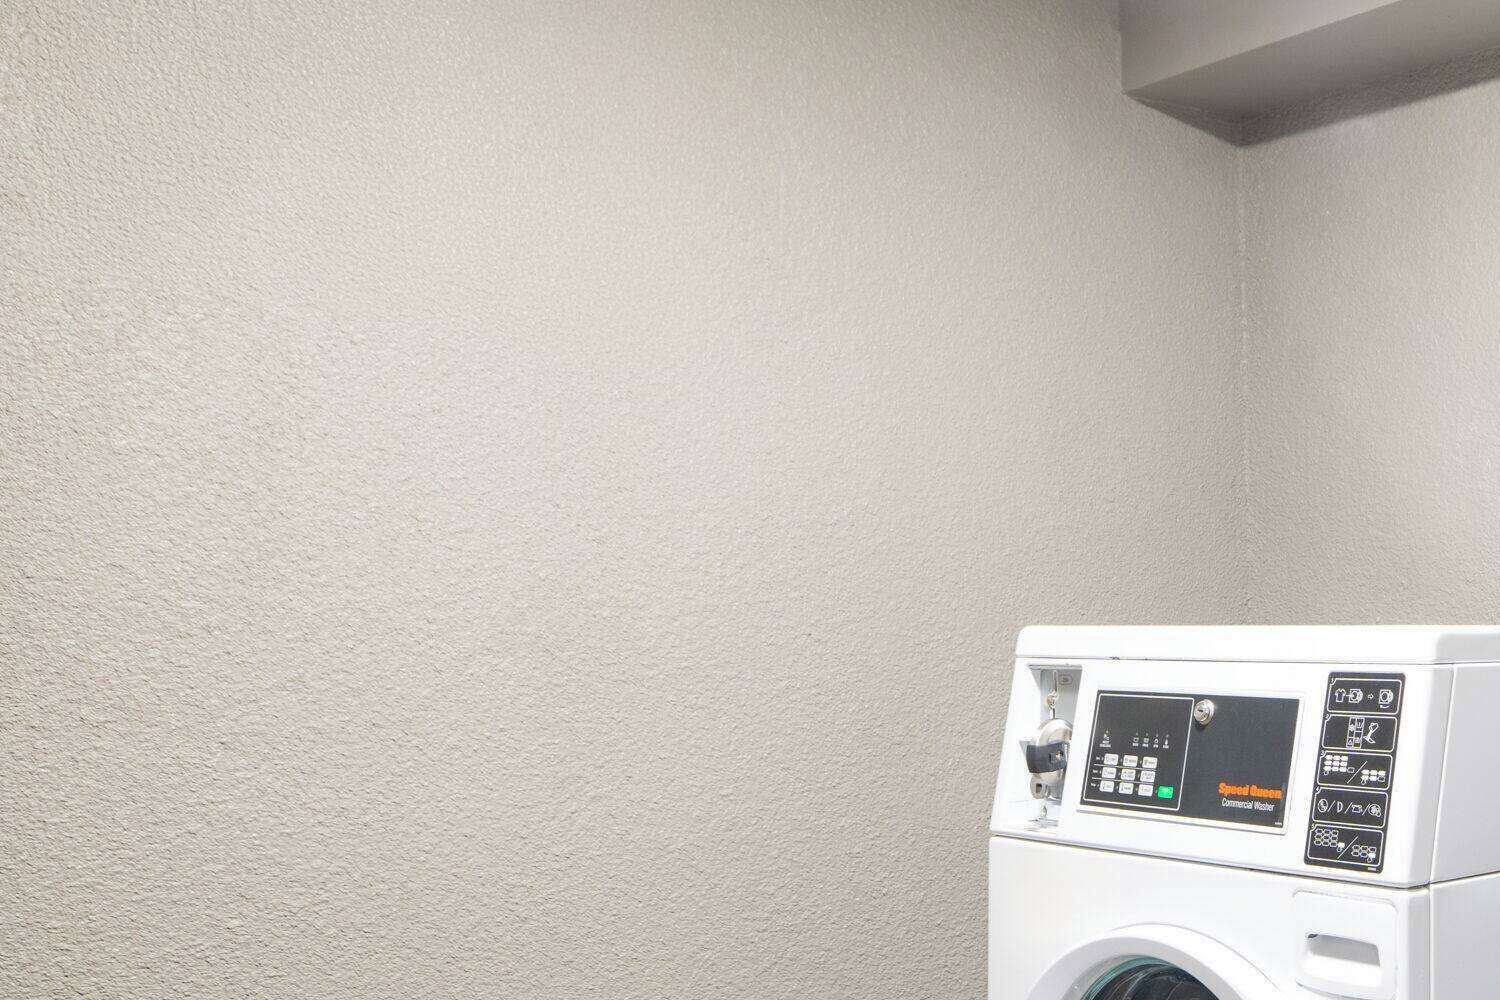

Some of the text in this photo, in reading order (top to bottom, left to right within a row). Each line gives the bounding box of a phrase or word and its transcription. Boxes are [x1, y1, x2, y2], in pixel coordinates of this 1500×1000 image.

[1218, 783, 1282, 798] Speed Queen
[1221, 798, 1275, 811] Commercial Washer
